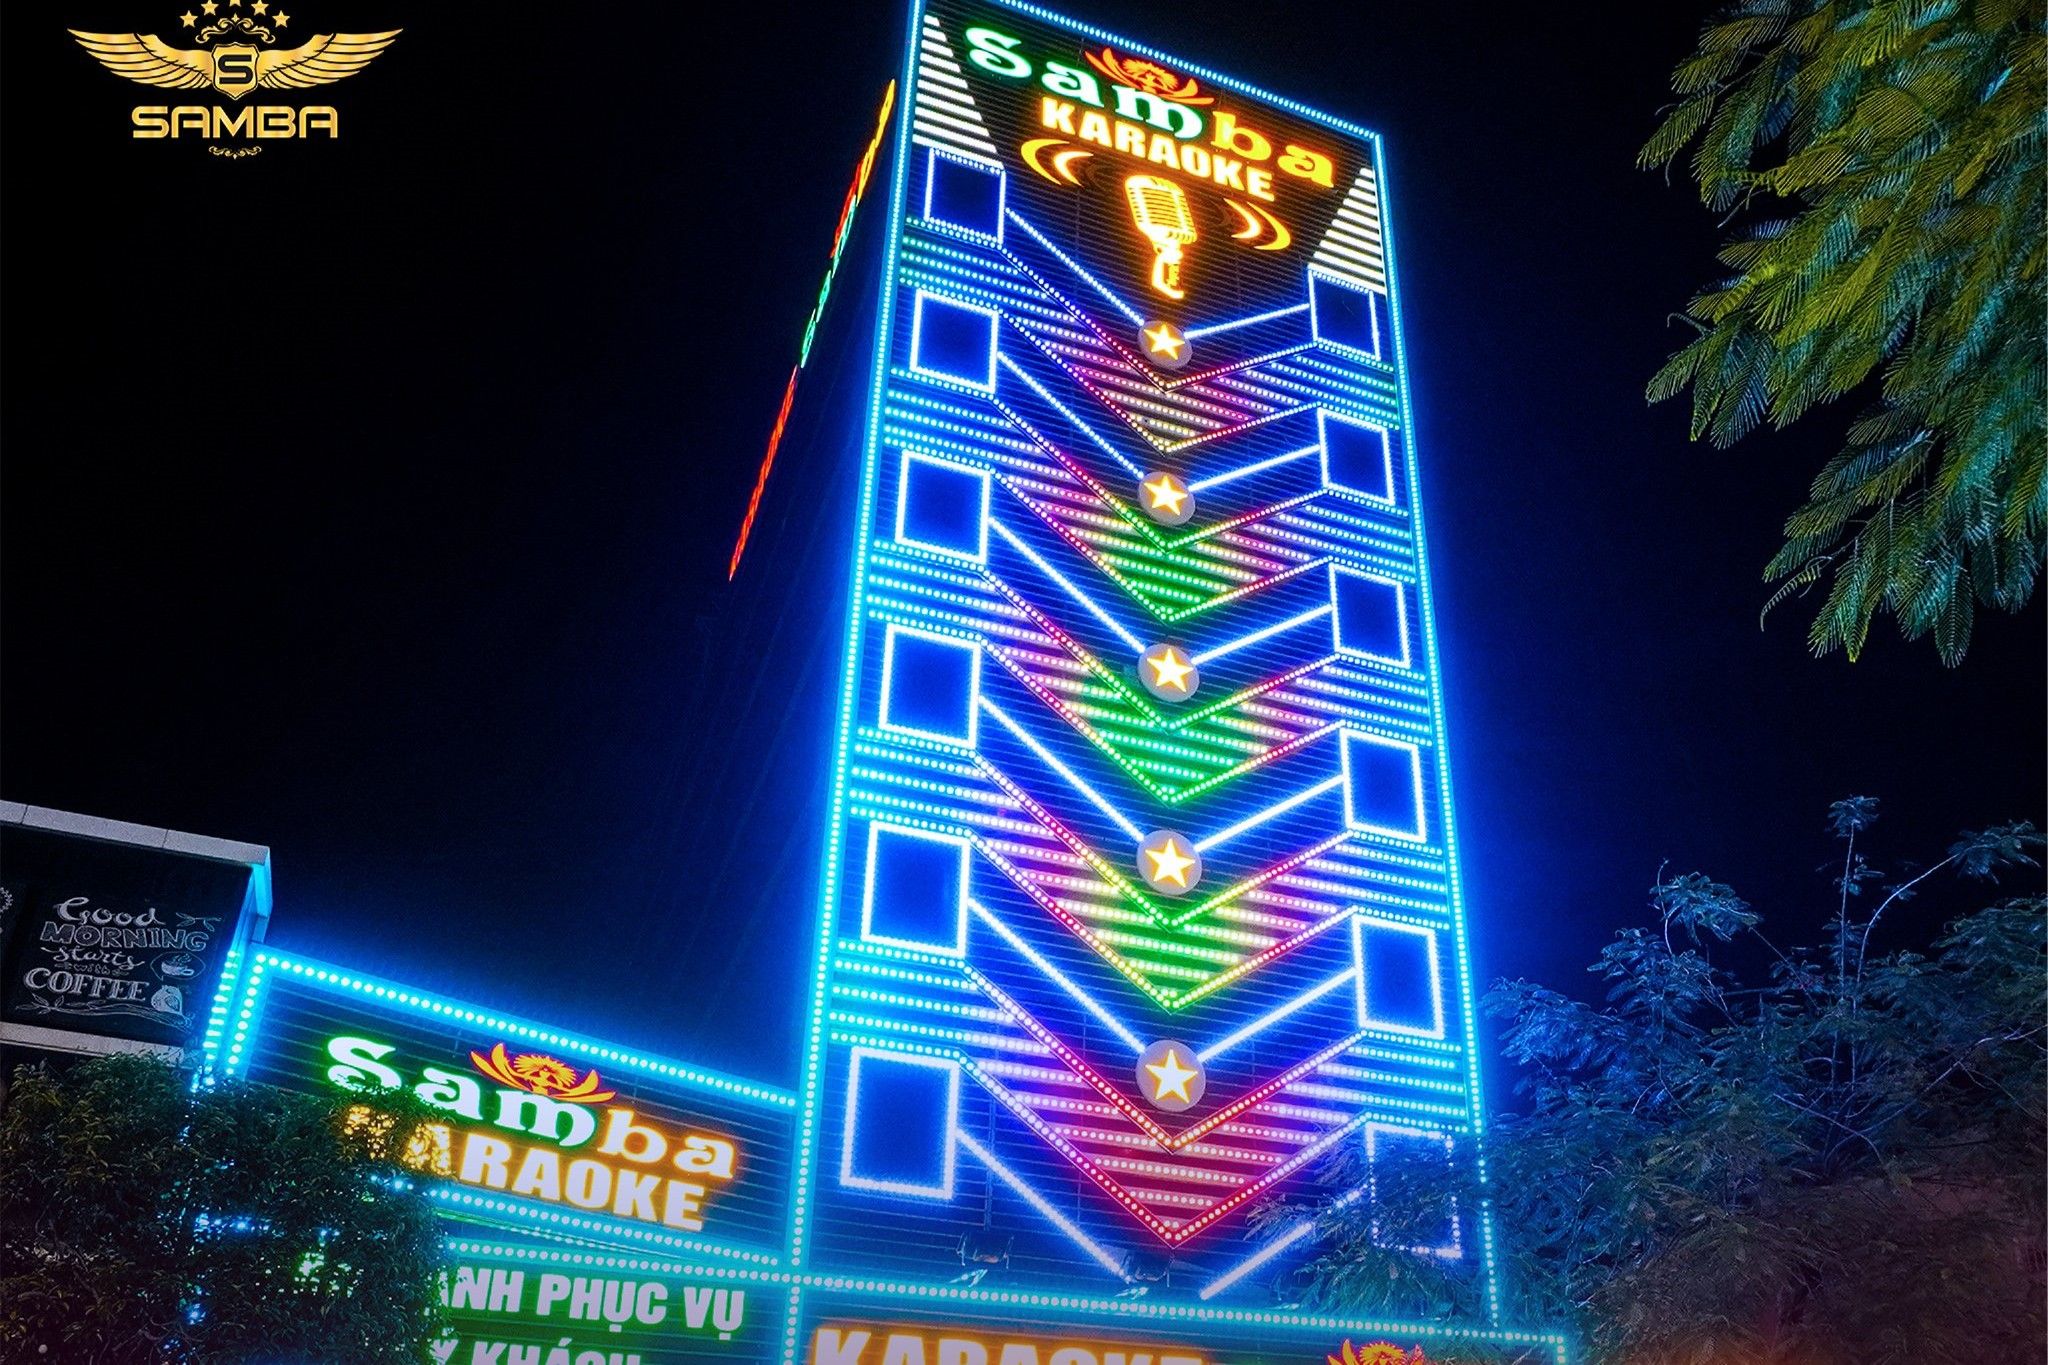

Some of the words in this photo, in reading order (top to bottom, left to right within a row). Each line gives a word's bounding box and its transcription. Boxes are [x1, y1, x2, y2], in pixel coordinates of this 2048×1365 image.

[964, 26, 1334, 188] Samba
[1042, 96, 1275, 202] KARAOKE
[40, 921, 209, 951] MORNING
[53, 896, 166, 926] Good
[40, 945, 146, 970] starts
[22, 967, 150, 1001] COFFEE
[325, 1034, 737, 1180] Samba
[536, 1273, 669, 1333] PHỤC
[683, 1286, 746, 1341] VỤ
